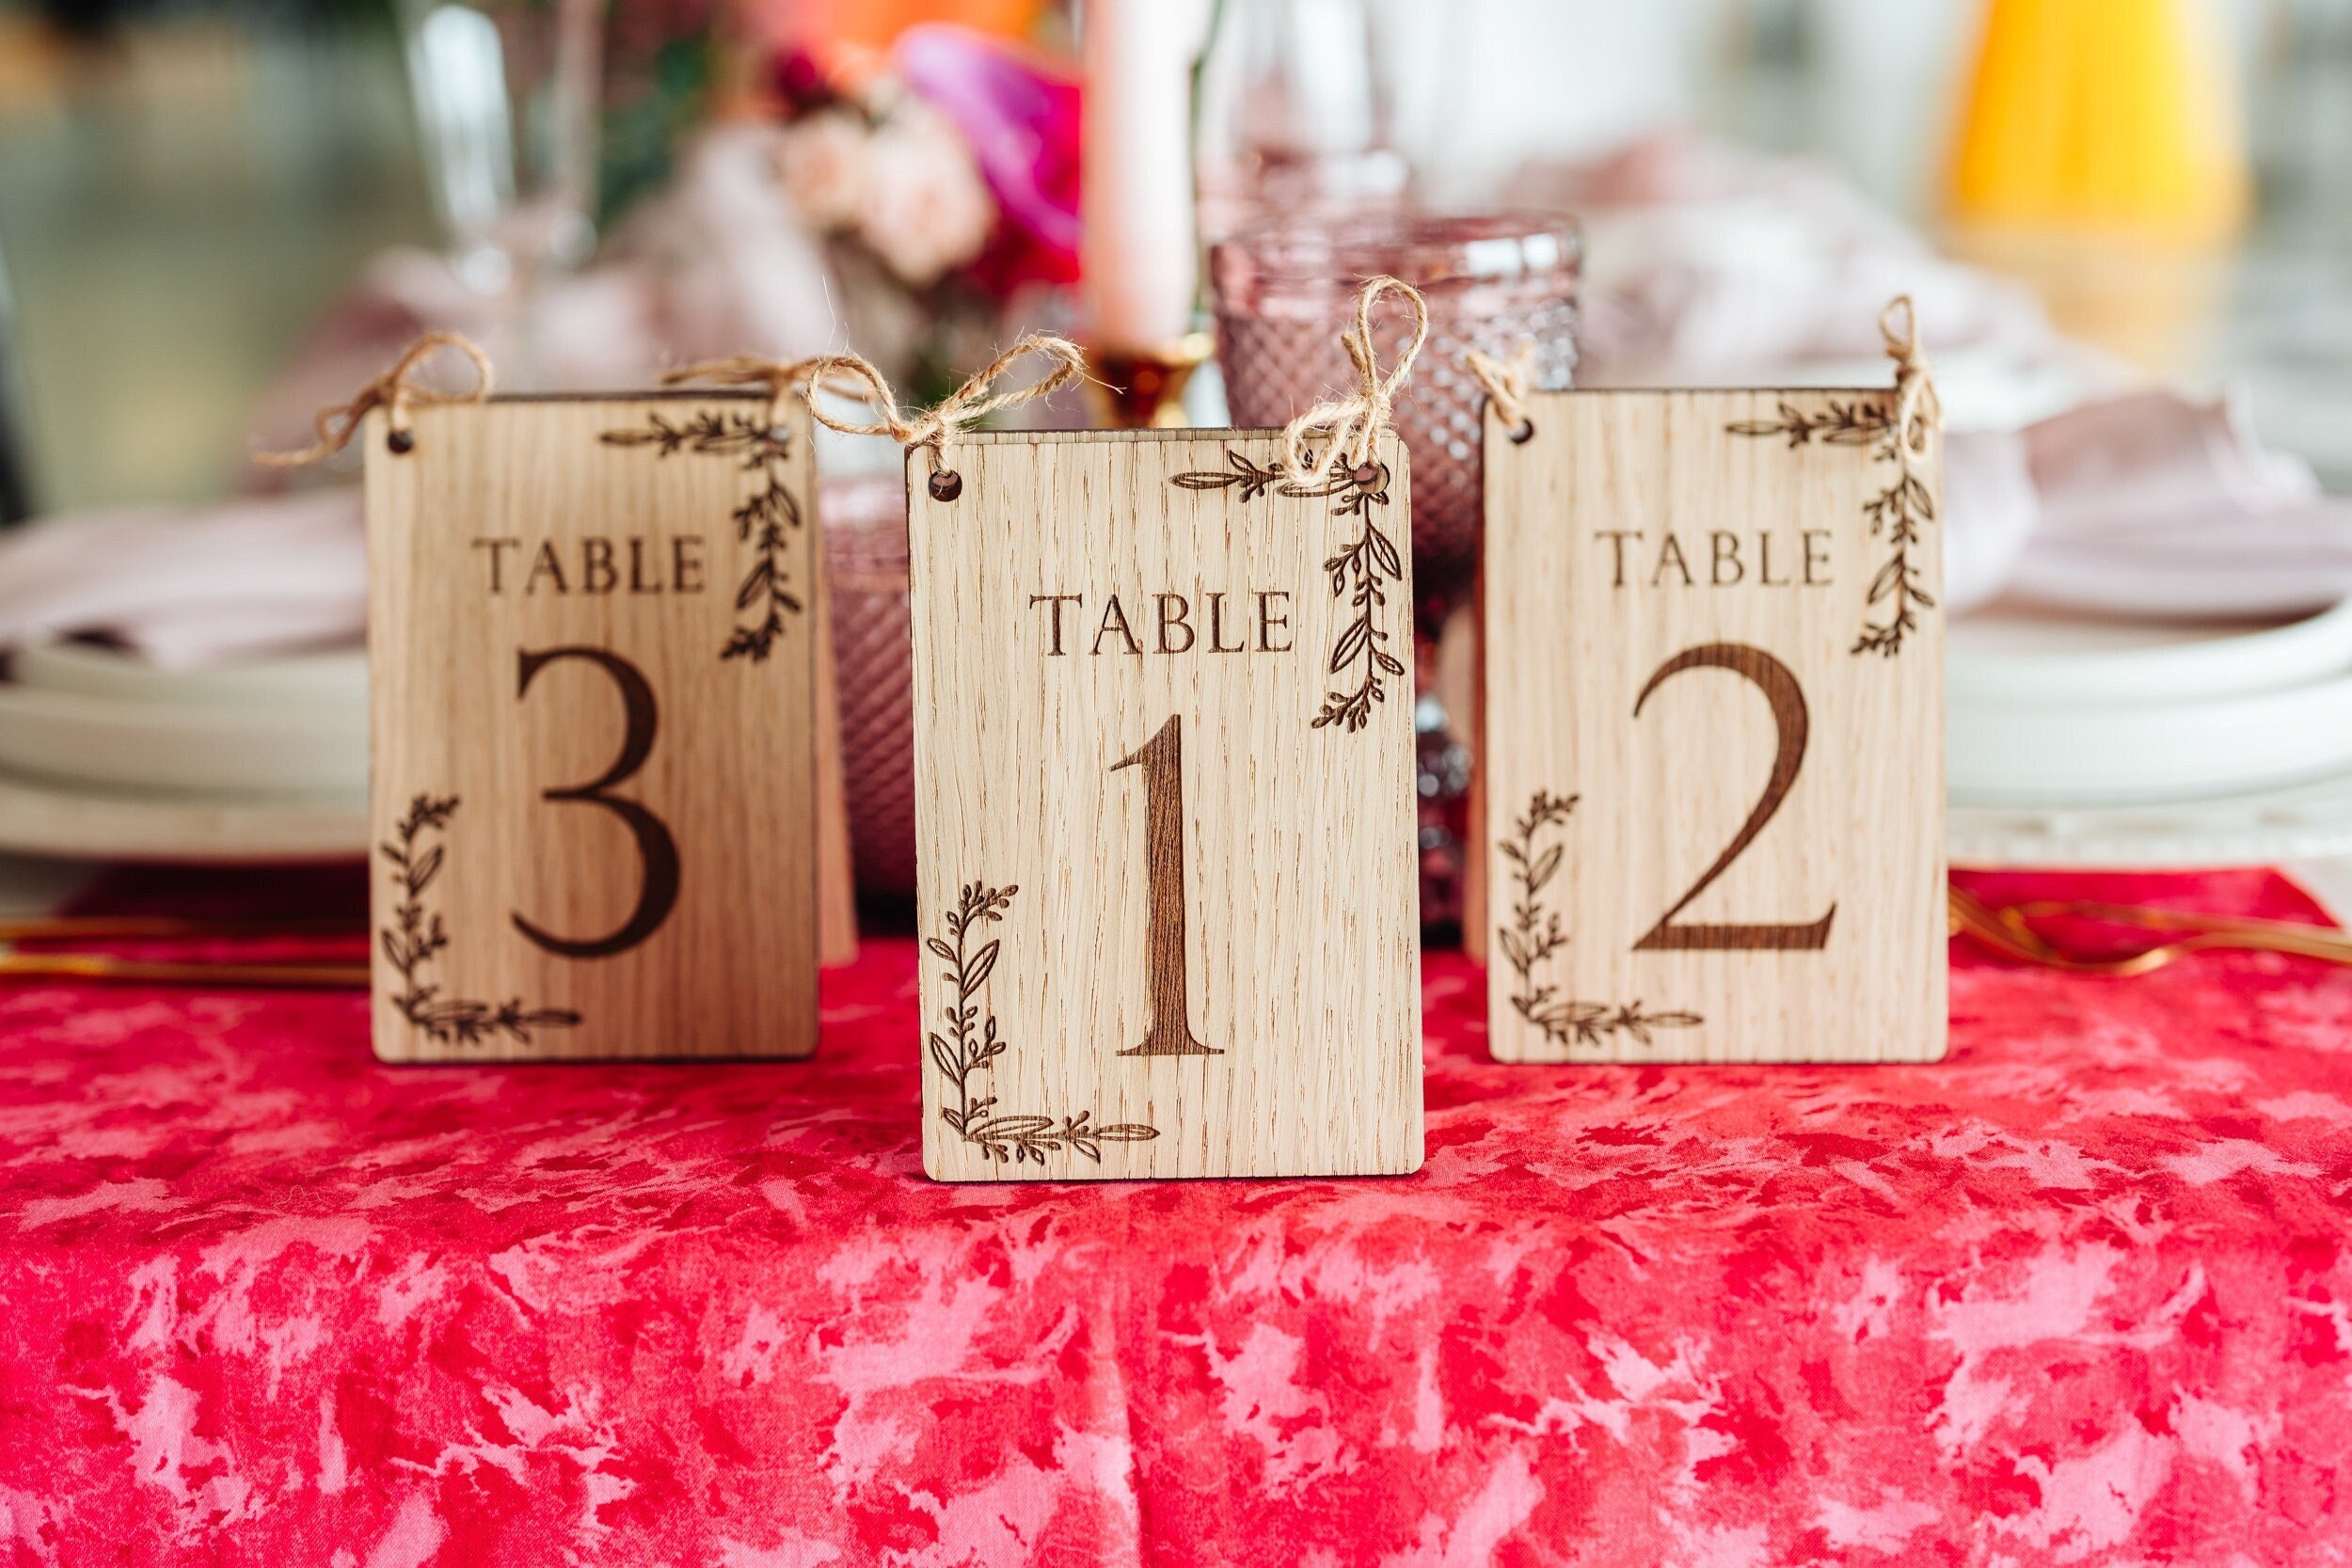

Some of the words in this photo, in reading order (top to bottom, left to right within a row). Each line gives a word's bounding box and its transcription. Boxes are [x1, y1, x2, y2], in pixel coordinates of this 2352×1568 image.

[471, 536, 707, 596] TABLE
[1028, 590, 1295, 658] TABLE
[1594, 529, 1836, 590] TABLE
[511, 645, 683, 959] 3
[1110, 713, 1227, 1057] 1
[1631, 641, 1838, 952] 2
